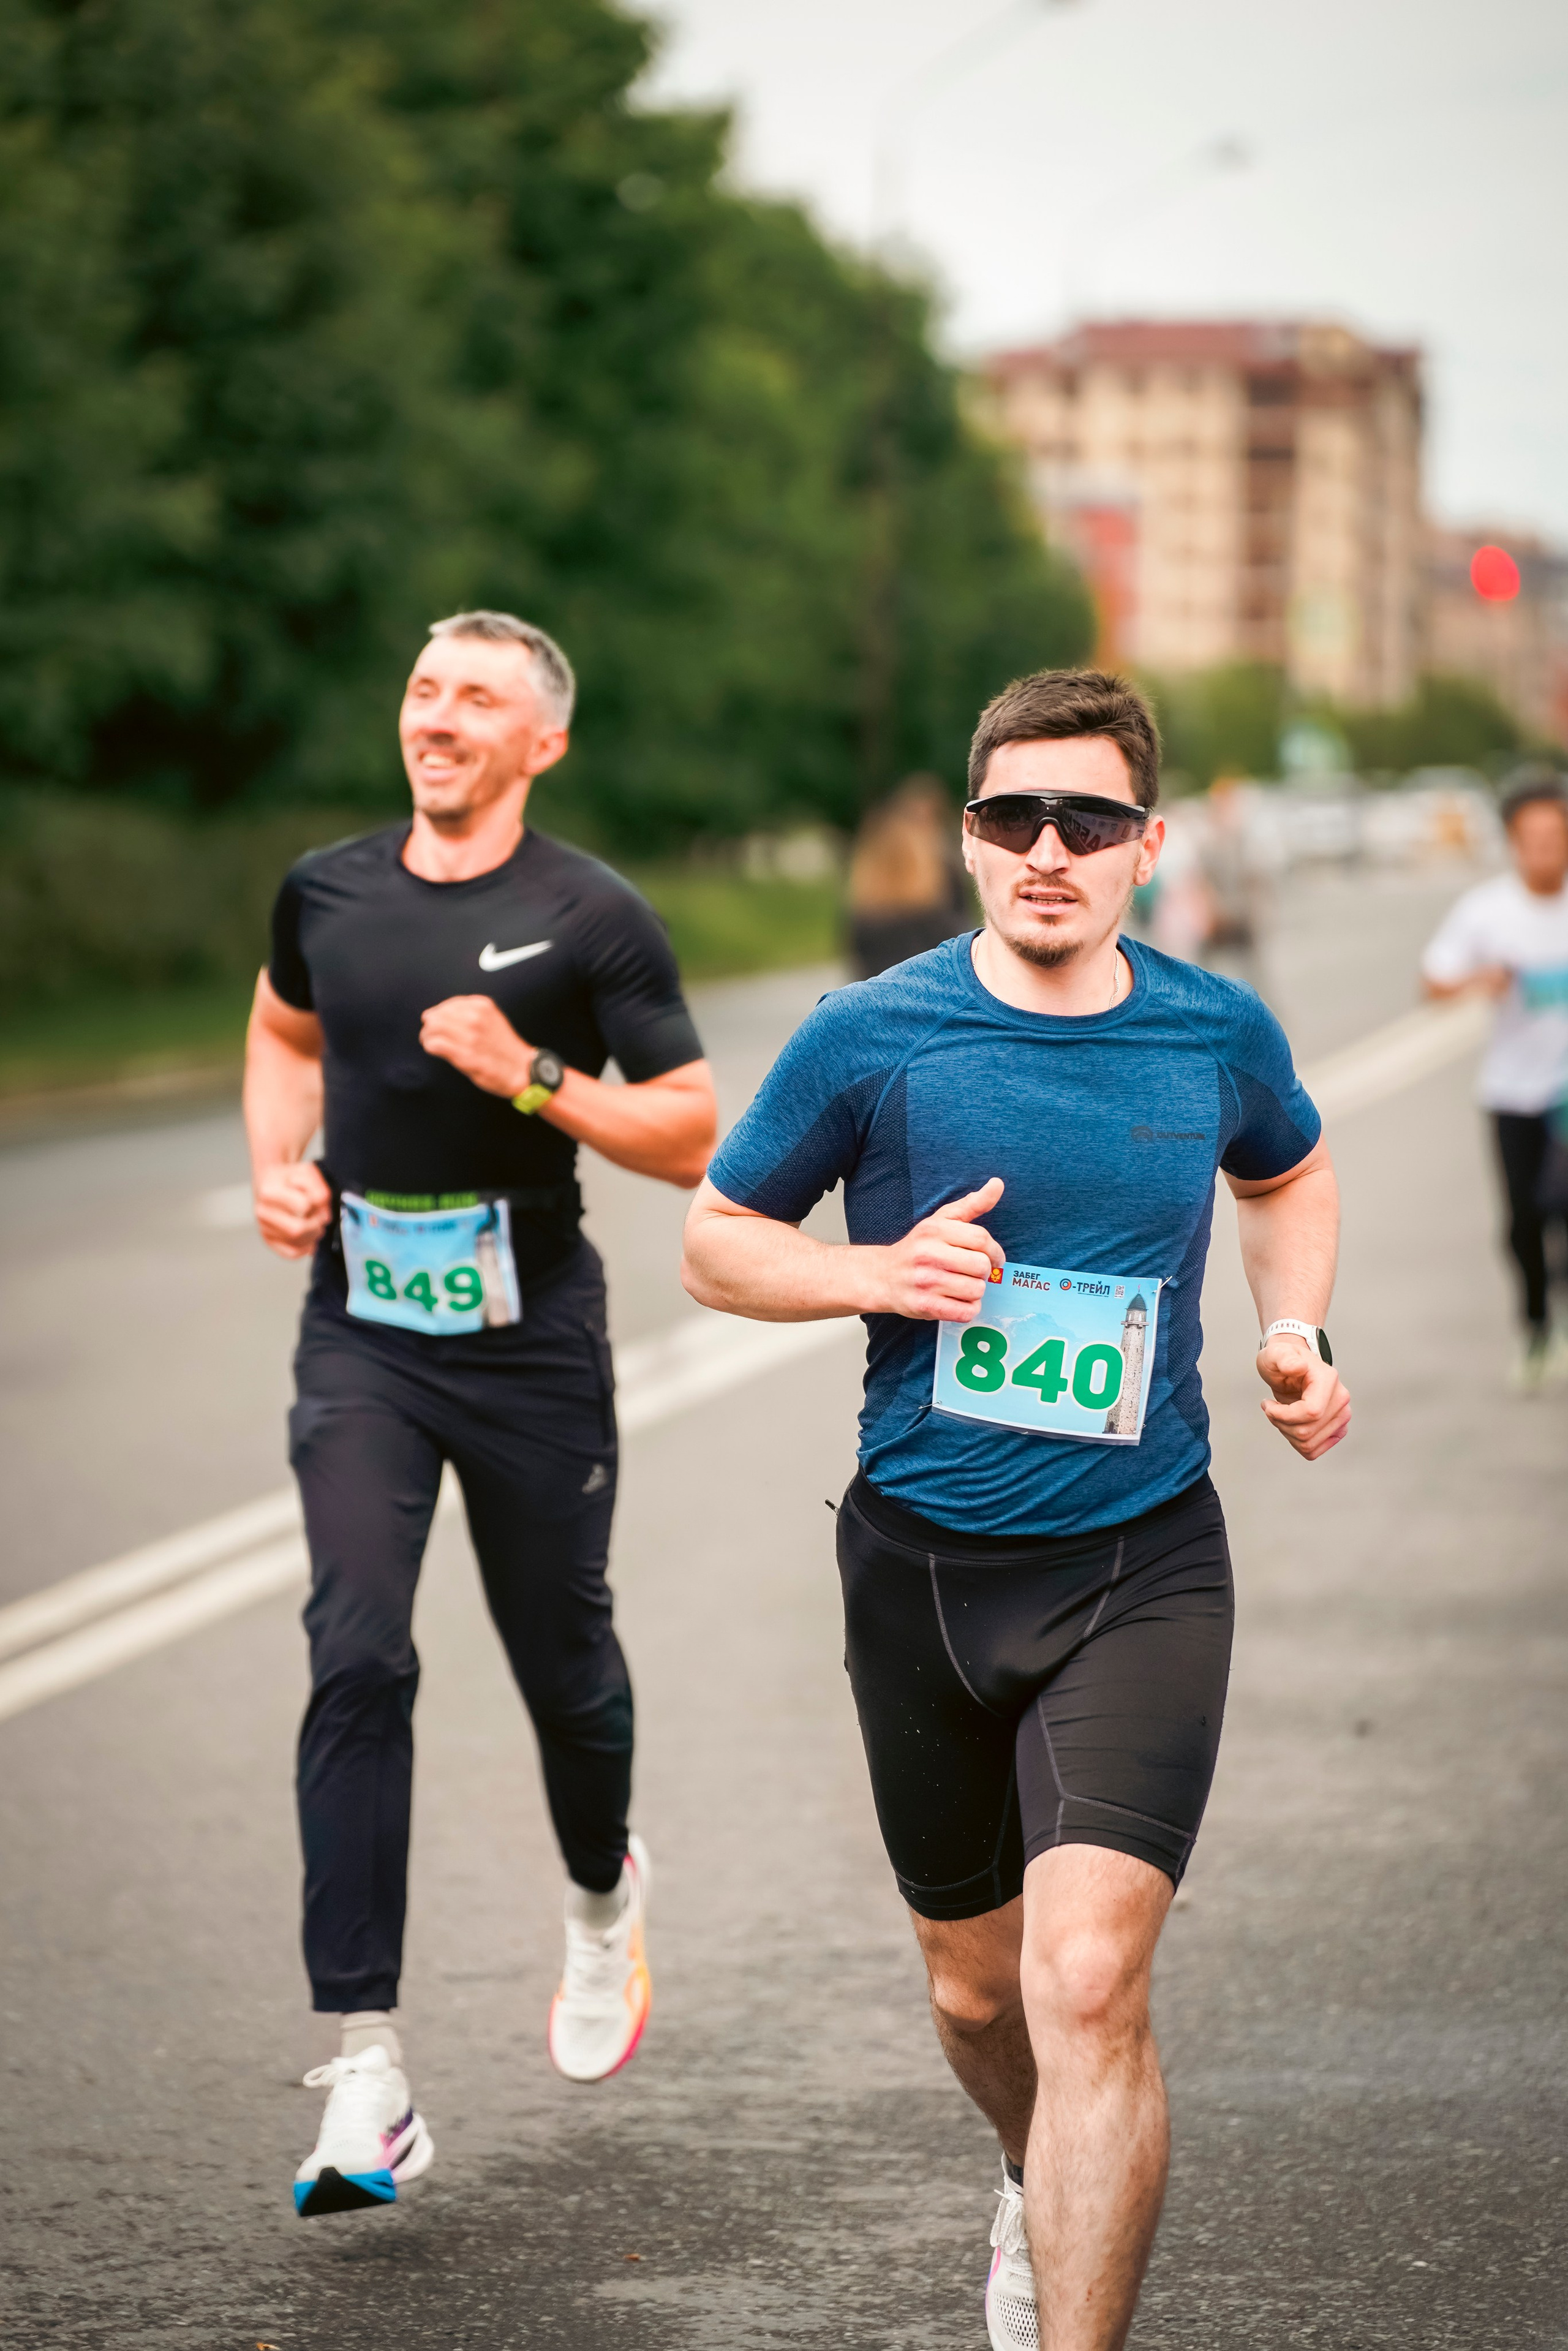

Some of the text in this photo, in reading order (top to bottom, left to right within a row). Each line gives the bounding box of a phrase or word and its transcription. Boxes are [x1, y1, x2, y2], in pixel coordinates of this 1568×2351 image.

[365, 1260, 483, 1312] 849
[1012, 1278, 1050, 1291] МАГАС
[1014, 1270, 1040, 1280] ЗАБЕГ
[956, 1326, 1123, 1409] 840
